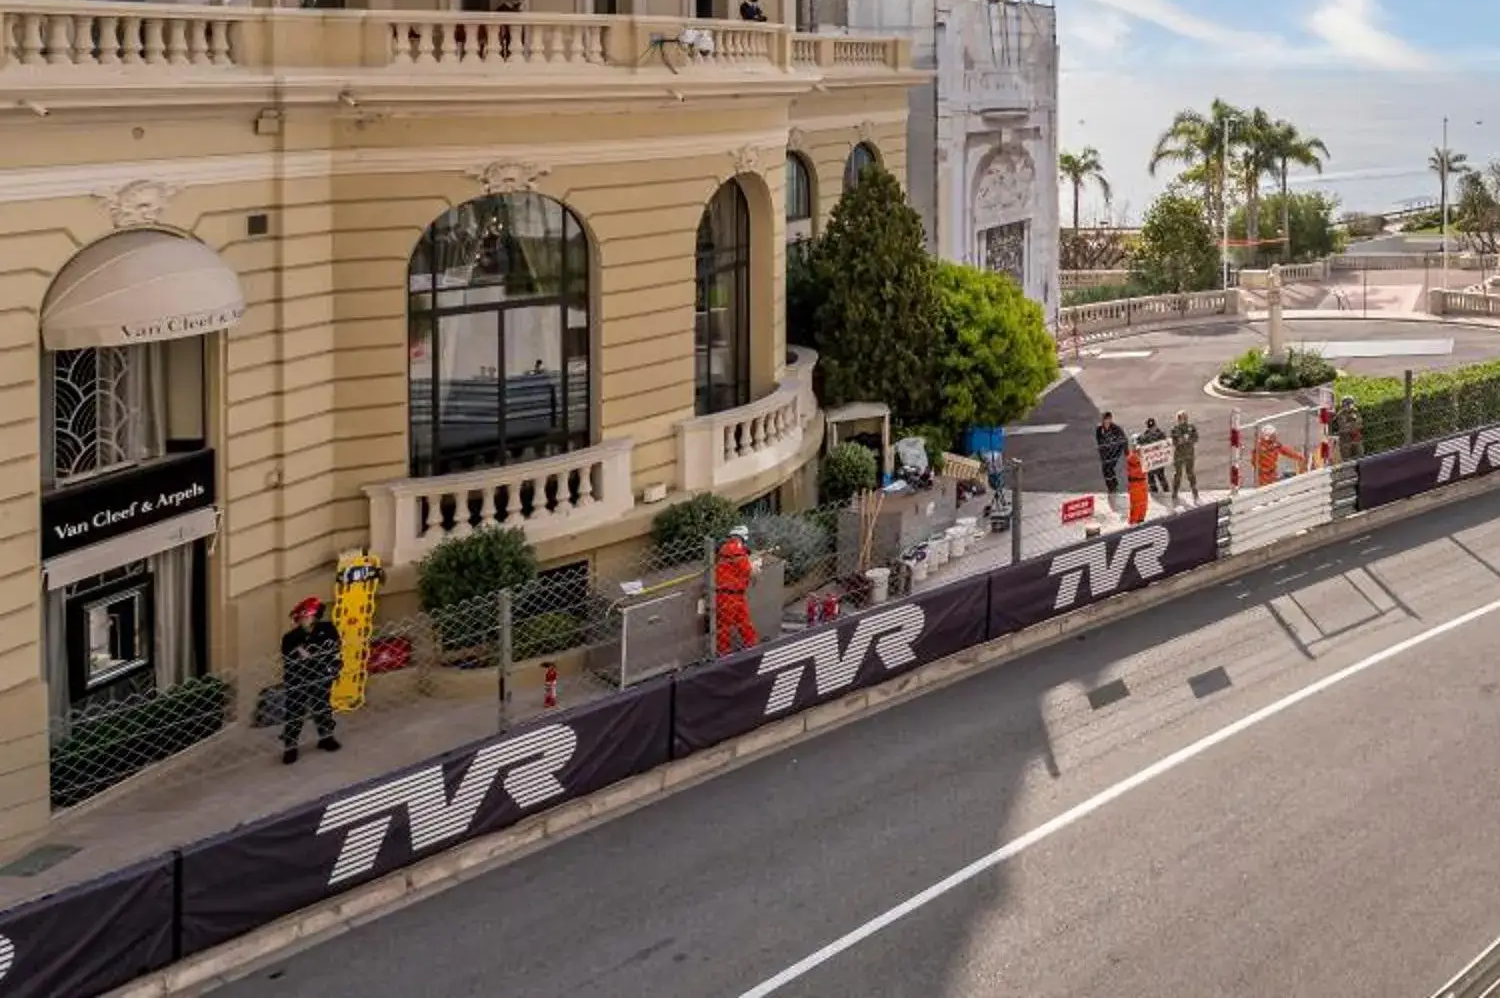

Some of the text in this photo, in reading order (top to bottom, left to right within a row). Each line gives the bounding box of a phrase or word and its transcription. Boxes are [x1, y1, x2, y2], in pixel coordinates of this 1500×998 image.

[120, 324, 161, 338] Van
[167, 315, 213, 333] Cleef
[54, 483, 204, 539] Van Cleef & Arpels
[1049, 525, 1170, 610] TVR
[757, 603, 925, 715] TVR
[317, 724, 577, 886] TVR
